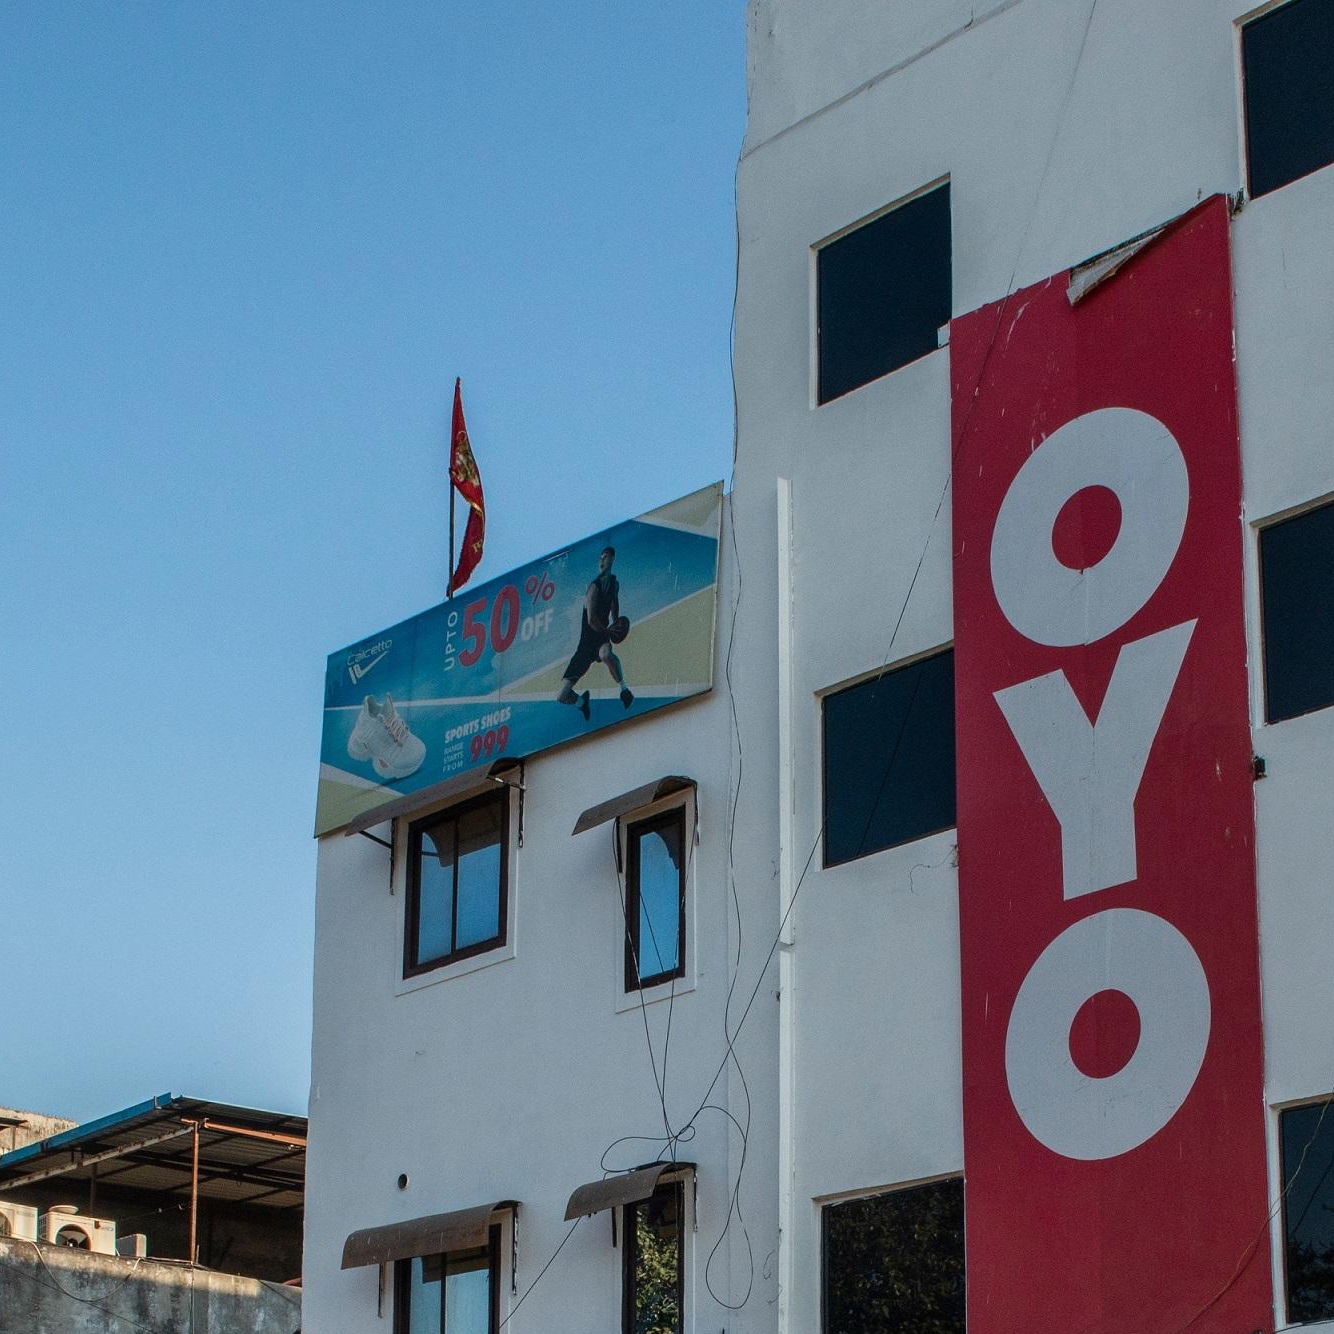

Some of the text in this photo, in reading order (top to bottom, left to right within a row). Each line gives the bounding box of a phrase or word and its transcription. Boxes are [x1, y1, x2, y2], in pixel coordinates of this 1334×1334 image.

[444, 611, 458, 672] UPTO
[519, 608, 554, 642] OFF
[445, 706, 512, 744] SPORTS SHOES
[470, 724, 510, 761] 999
[442, 761, 463, 773] FROM
[989, 406, 1212, 1161] OYO
